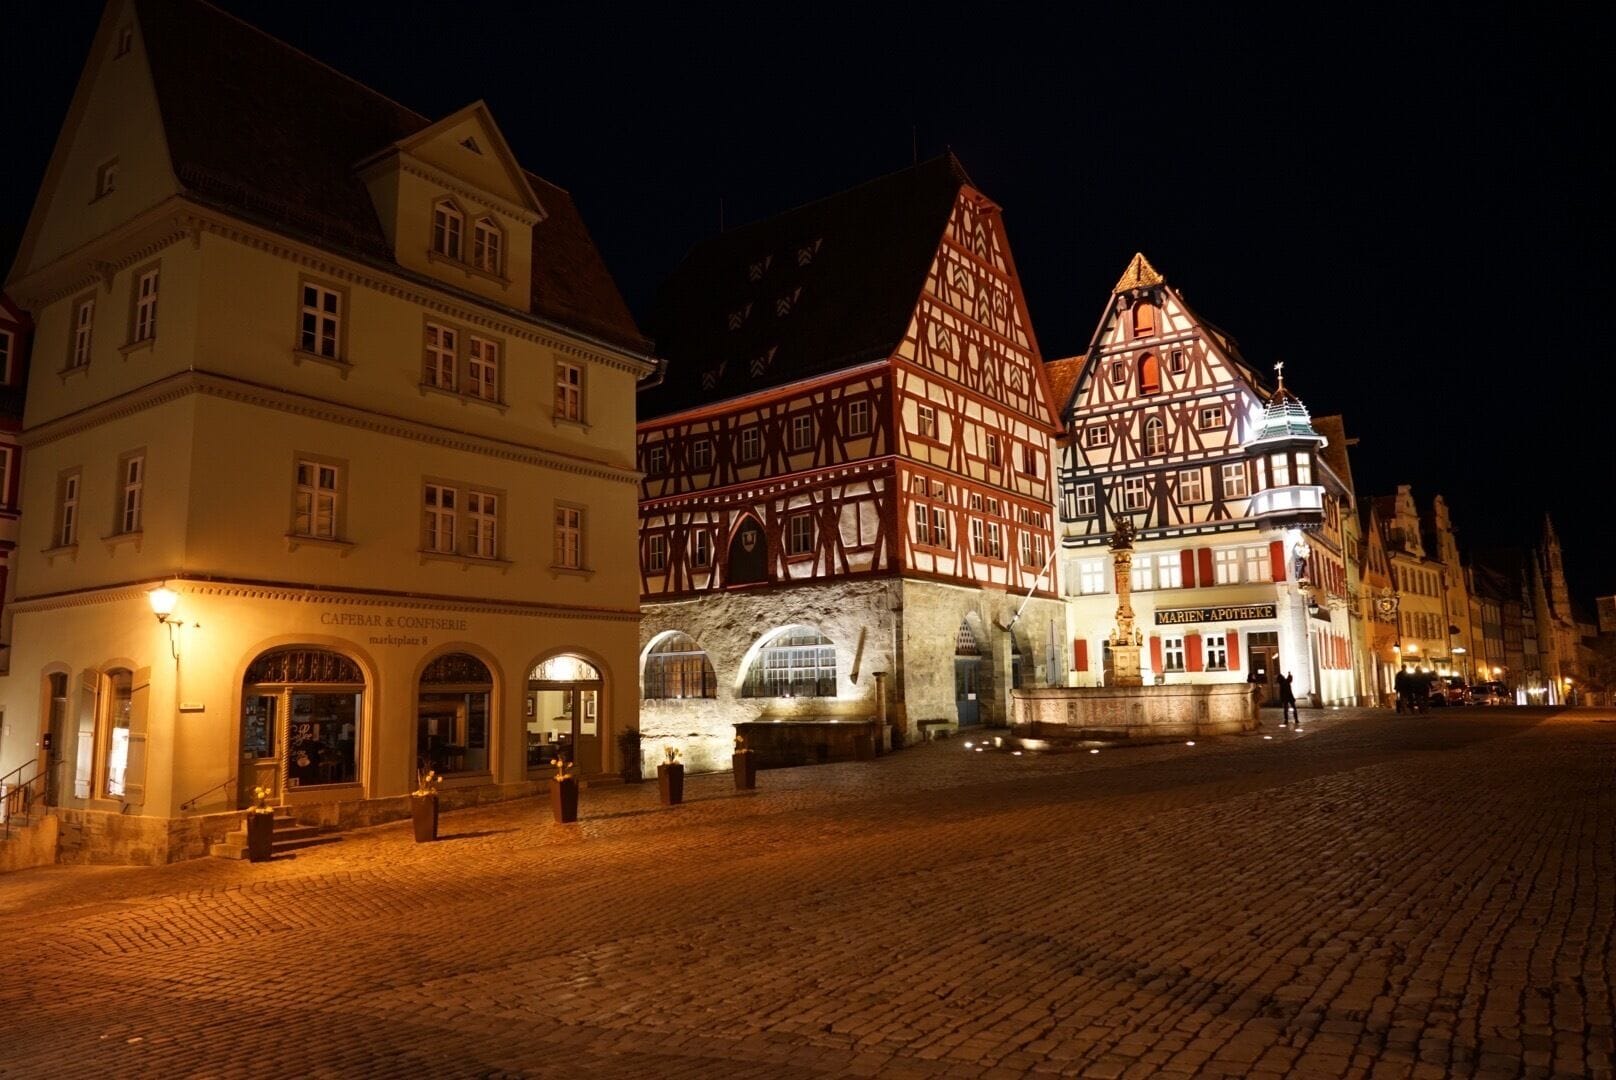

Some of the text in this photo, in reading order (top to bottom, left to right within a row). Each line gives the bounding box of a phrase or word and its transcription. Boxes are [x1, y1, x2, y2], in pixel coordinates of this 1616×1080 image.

[320, 612, 468, 631] CAFEBAR & CONFISERIE
[1159, 606, 1273, 624] MARIEN-APOTHEKE
[369, 635, 428, 648] marktplatz 8
